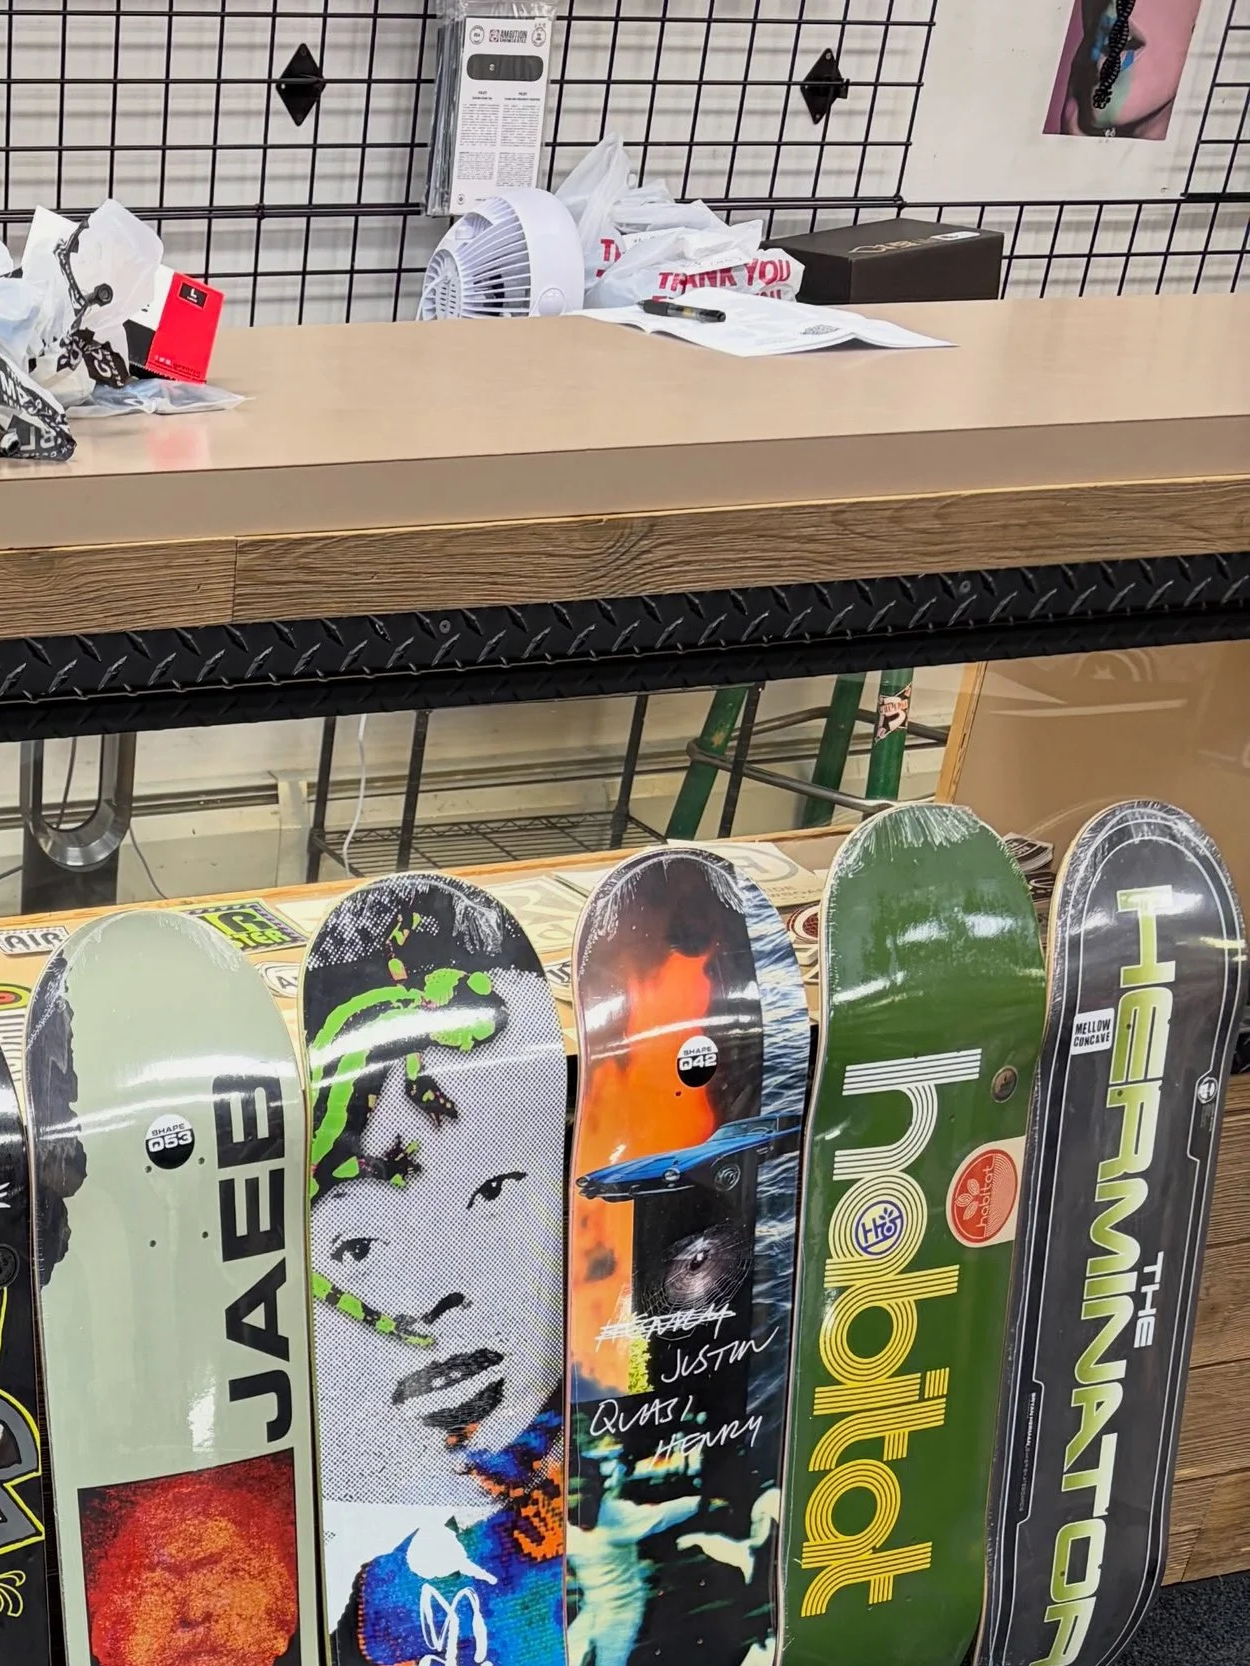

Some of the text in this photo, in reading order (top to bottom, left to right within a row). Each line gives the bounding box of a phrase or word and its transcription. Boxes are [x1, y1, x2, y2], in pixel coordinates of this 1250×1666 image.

[743, 257, 791, 287] YOU
[1075, 1018, 1112, 1036] MELLOW
[1073, 1031, 1111, 1048] CONCAVE
[683, 1045, 713, 1056] SHAPE
[677, 1053, 718, 1071] Q42
[150, 1122, 187, 1138] SHAPE
[147, 1131, 194, 1153] Q53
[975, 1164, 995, 1229] habitat
[1134, 1250, 1164, 1348] THE
[801, 1048, 983, 1618] habitat
